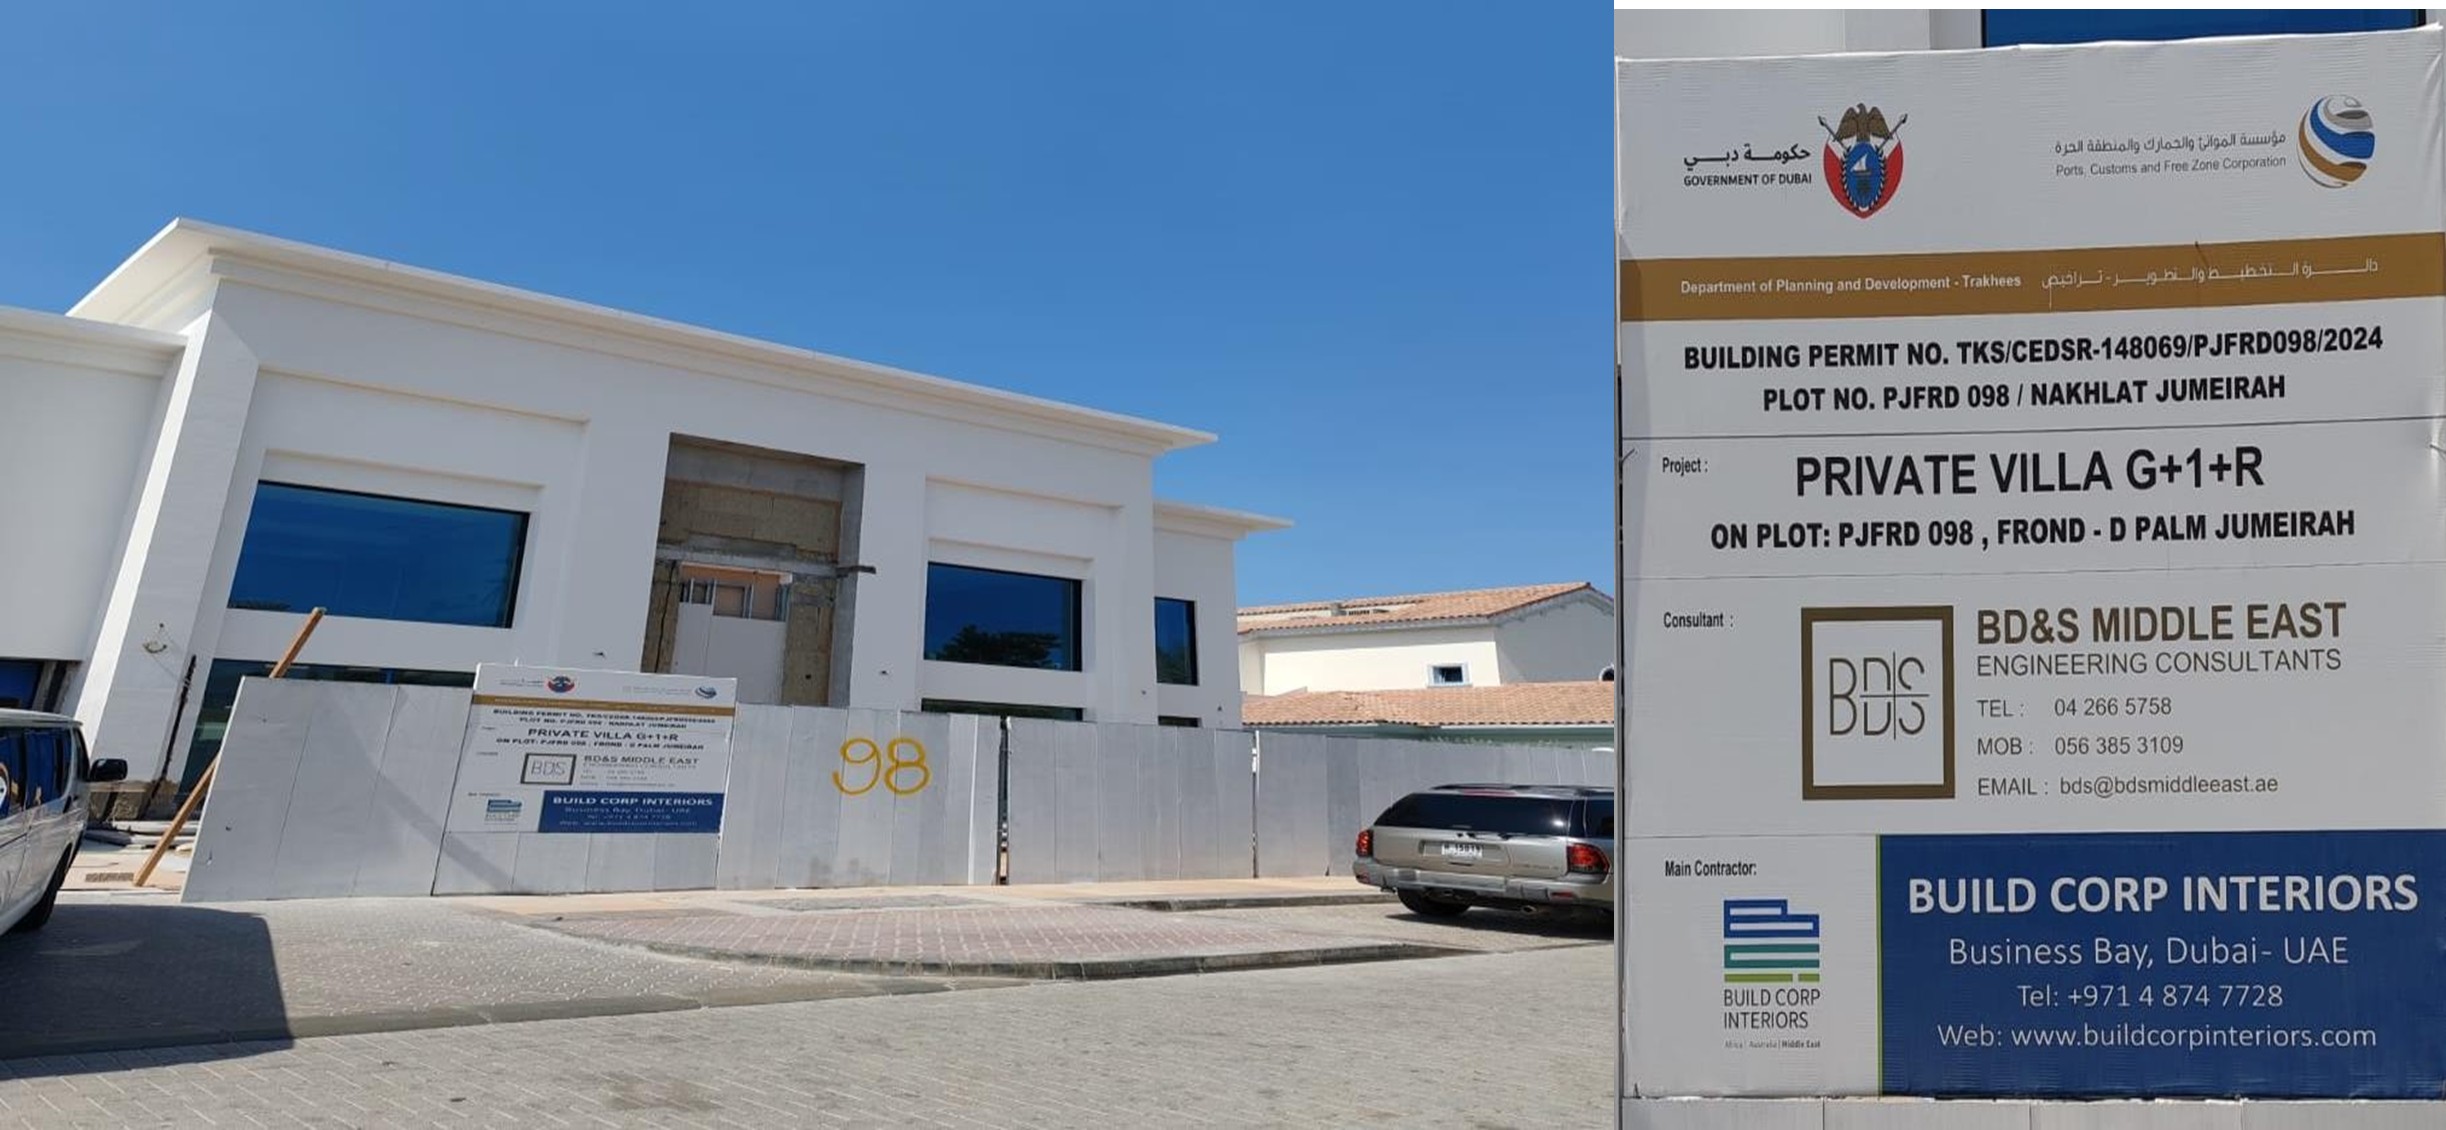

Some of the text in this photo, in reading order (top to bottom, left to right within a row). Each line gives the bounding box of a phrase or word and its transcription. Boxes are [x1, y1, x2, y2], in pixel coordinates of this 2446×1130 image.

[2090, 161, 2137, 175] Customs
[2140, 160, 2161, 173] and
[2164, 159, 2188, 172] Free
[2191, 158, 2220, 172] Zone
[2223, 155, 2286, 174] Corporation
[1684, 173, 1812, 186] GOVERNMENT OF DUBAI
[1681, 279, 1756, 296] Department
[1759, 279, 1773, 293] of
[1776, 277, 1834, 295] Planning
[1837, 277, 1861, 292] and
[1865, 275, 1951, 293] Development
[1962, 274, 2022, 289] Trakhees
[1684, 325, 2384, 369] BUILDING PERMIT NO. TKS/CEDSR-148069/PJFRD098/2024
[1764, 374, 2286, 411] PLOT NO. PJFRD 098 / NAKHLAT JUMEIRAH
[1662, 457, 1701, 477] Project
[1796, 446, 2265, 497] PRIVATE VILLA G+1+R
[1710, 523, 1748, 549] ON
[1756, 522, 1831, 549] PLOT:
[1838, 520, 1921, 548] PJFRD
[1928, 519, 1974, 547] 098
[1998, 516, 2086, 545] FROND
[2109, 516, 2127, 542] D
[2135, 514, 2207, 541] PALM
[2214, 509, 2355, 539] JUMEIRAH
[1663, 611, 1724, 628] Consultant
[1977, 602, 2347, 644] BD&S MIDDLE EAST
[1977, 648, 2342, 676] ENGINEERING CONSULTANTS
[1829, 654, 1926, 737] BDS
[1976, 699, 2014, 718] TEL
[2054, 698, 2077, 717] 04
[2083, 697, 2119, 717] 266
[2125, 697, 2173, 716] 5758
[528, 728, 590, 739] PRIVATE
[593, 731, 632, 740] VILLA
[1977, 737, 2023, 756] MOB
[2054, 736, 2090, 755] 056
[2095, 736, 2131, 755] 385
[2137, 735, 2184, 754] 3109
[669, 757, 700, 765] EAST
[832, 737, 931, 796] 98
[1978, 777, 2037, 796] EMAIL
[2060, 775, 2279, 798] bds@bdsmiddleeast.ae
[552, 796, 713, 806] BUILD CORP INTERIORS
[1665, 859, 1757, 877] Main Contractor:
[1908, 874, 2419, 914] BUILD CORP INTERIORS
[1950, 936, 2349, 971] Business Bay, Dubai- UAE
[1724, 988, 1821, 1007] BUILD CORP
[2017, 983, 2283, 1007] Tel: +971 4 874 7728
[1724, 1011, 1809, 1030] INTERIORS
[1782, 1039, 1805, 1049] Middle
[1806, 1039, 1821, 1049] East
[1937, 1022, 2377, 1050] Web: www.buildcorpinteriors.com
